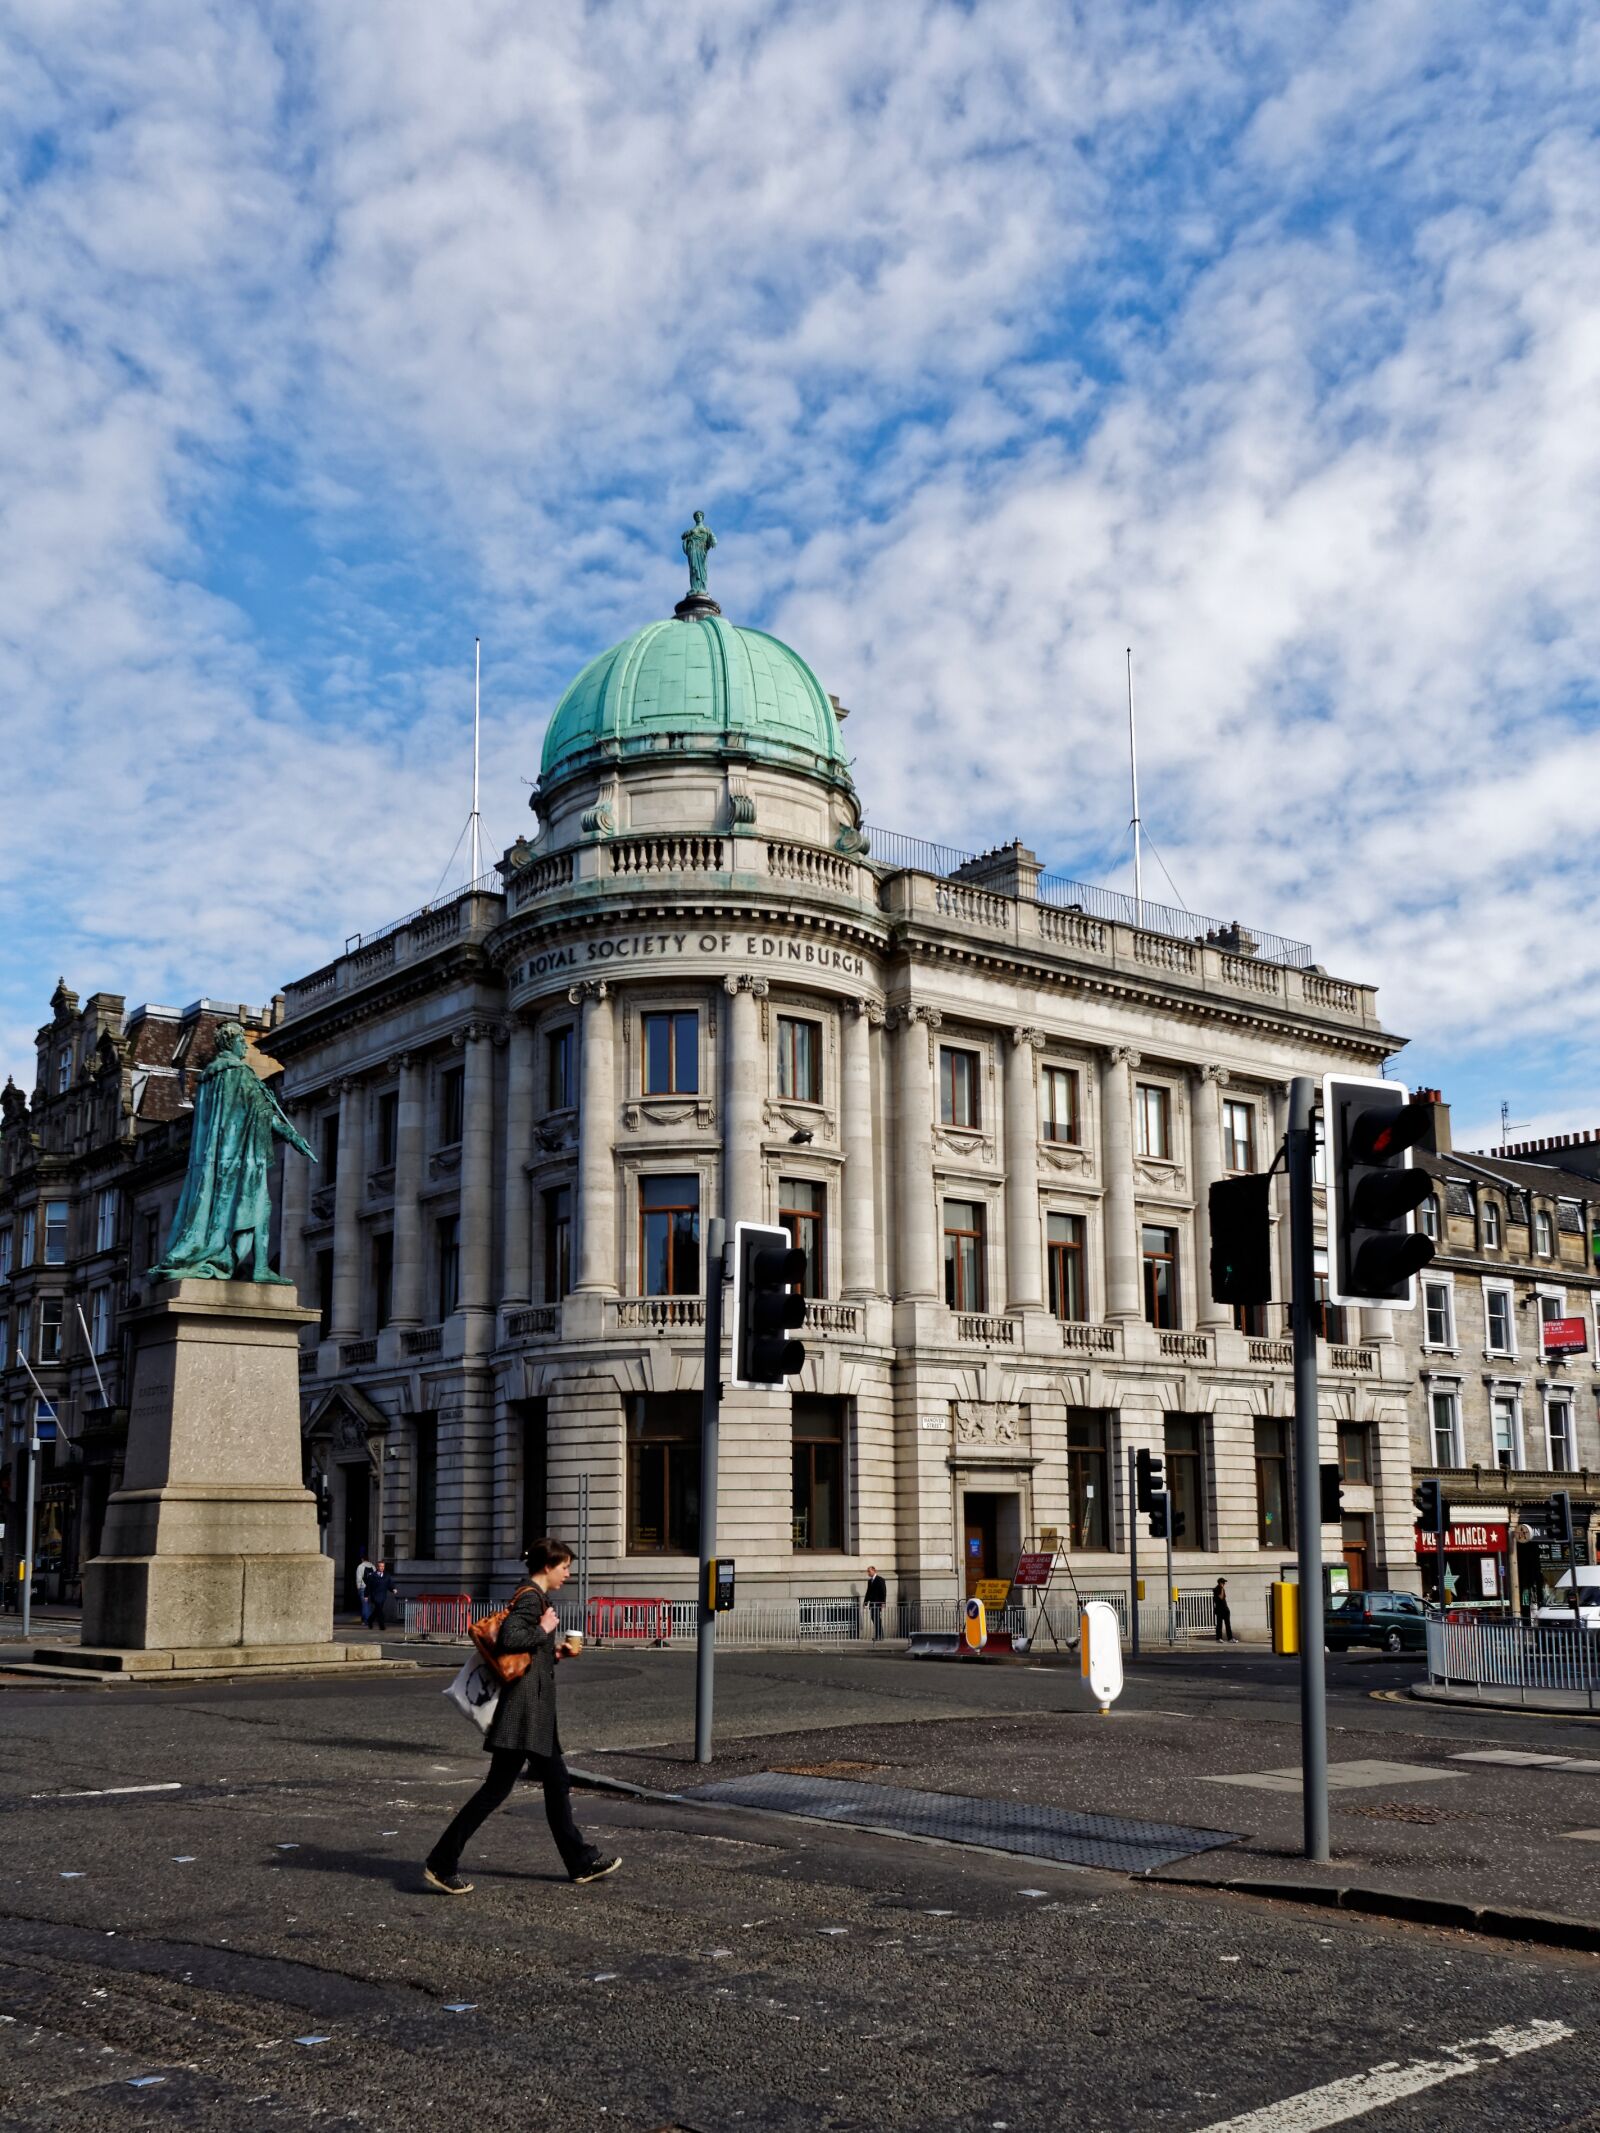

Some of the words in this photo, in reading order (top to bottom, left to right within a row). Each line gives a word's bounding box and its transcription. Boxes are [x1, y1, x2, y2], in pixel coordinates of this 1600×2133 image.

[528, 948, 577, 978] ROYAL
[587, 934, 687, 960] SOCIETY
[699, 934, 732, 953] OF
[747, 937, 864, 977] EDINBURGH
[1422, 1532, 1437, 1546] PRE
[1444, 1530, 1451, 1546] A
[1454, 1526, 1488, 1546] MANGER
